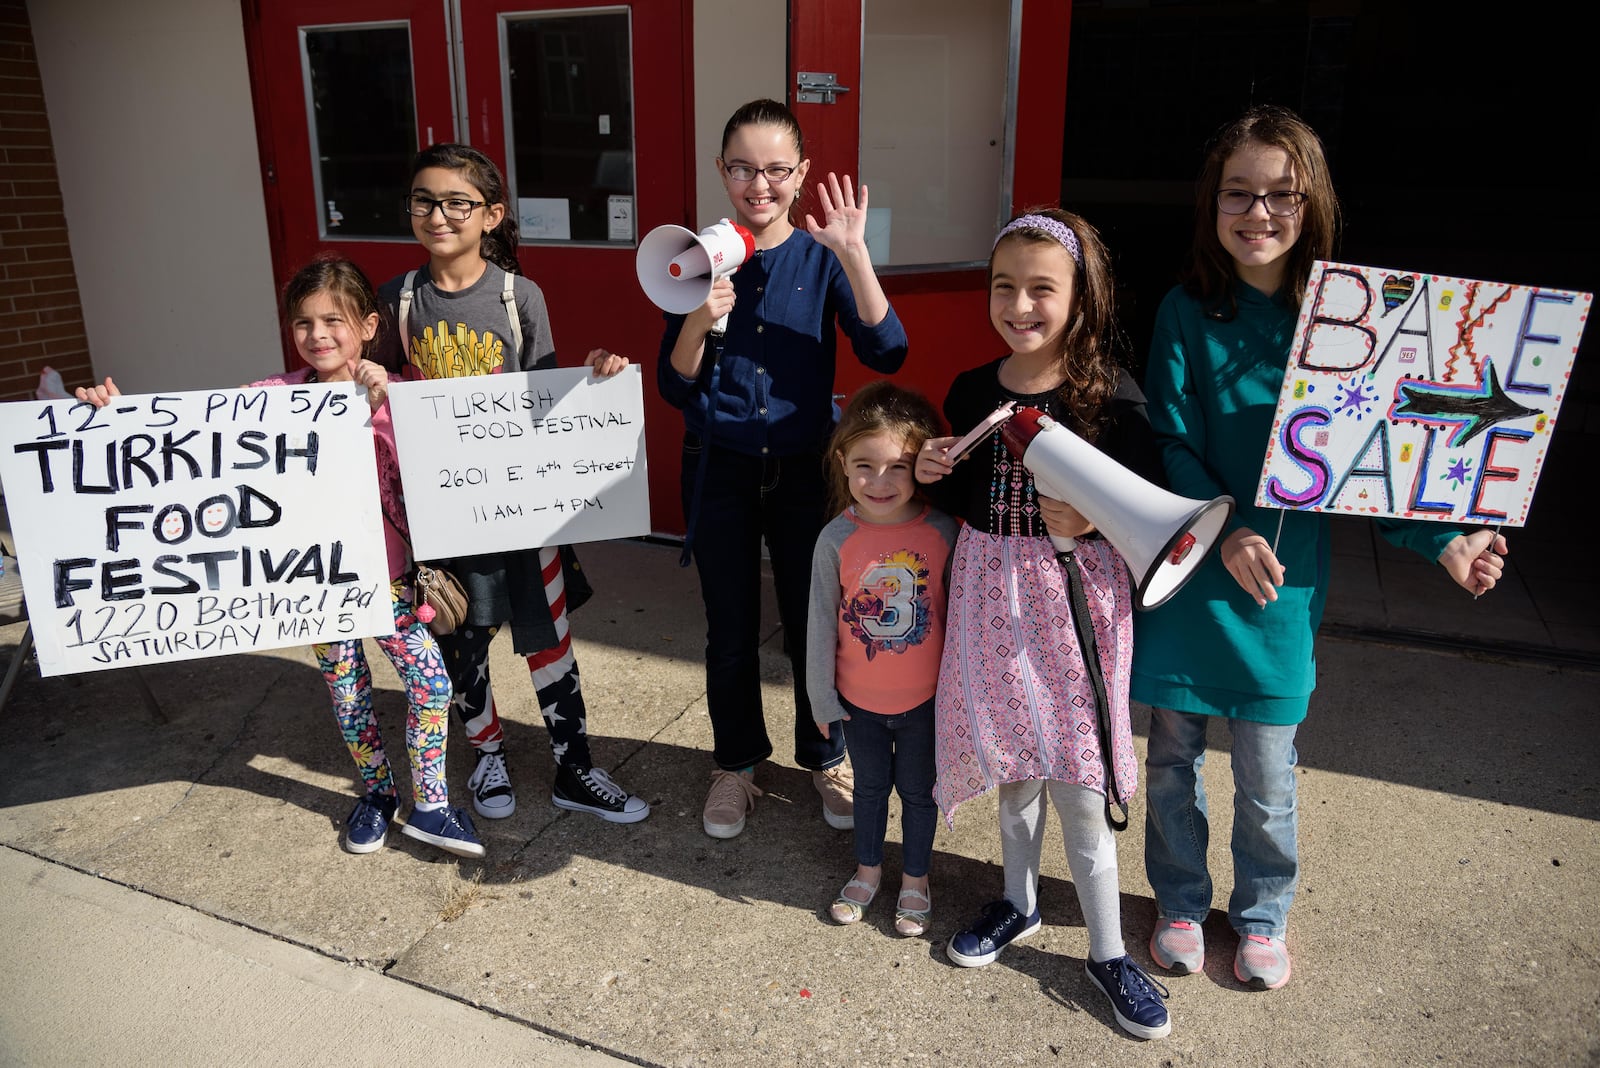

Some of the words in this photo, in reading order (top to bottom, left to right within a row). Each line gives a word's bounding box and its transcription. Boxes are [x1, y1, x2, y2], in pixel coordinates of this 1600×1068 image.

[1298, 268, 1576, 396] BAKE
[1400, 351, 1415, 359] YES
[205, 390, 268, 423] PM
[290, 389, 348, 422] 5/5
[421, 389, 554, 419] TURKISH
[457, 421, 523, 443] FOOD
[532, 411, 632, 436] FESTIVAL
[14, 430, 320, 494] TURKISH
[439, 467, 488, 489] 2601
[507, 466, 523, 482] E.
[536, 461, 561, 478] 4th
[573, 456, 635, 475] Street
[1266, 405, 1535, 521] SALE
[105, 484, 281, 552] FOOD
[53, 540, 360, 609] FESTIVAL
[859, 563, 917, 640] 3
[65, 601, 178, 648] 1220
[194, 589, 328, 626] Bethel
[340, 583, 378, 609] Rd
[92, 623, 262, 664] SATURDAY
[278, 616, 325, 641] MAY
[337, 613, 356, 633] 5
